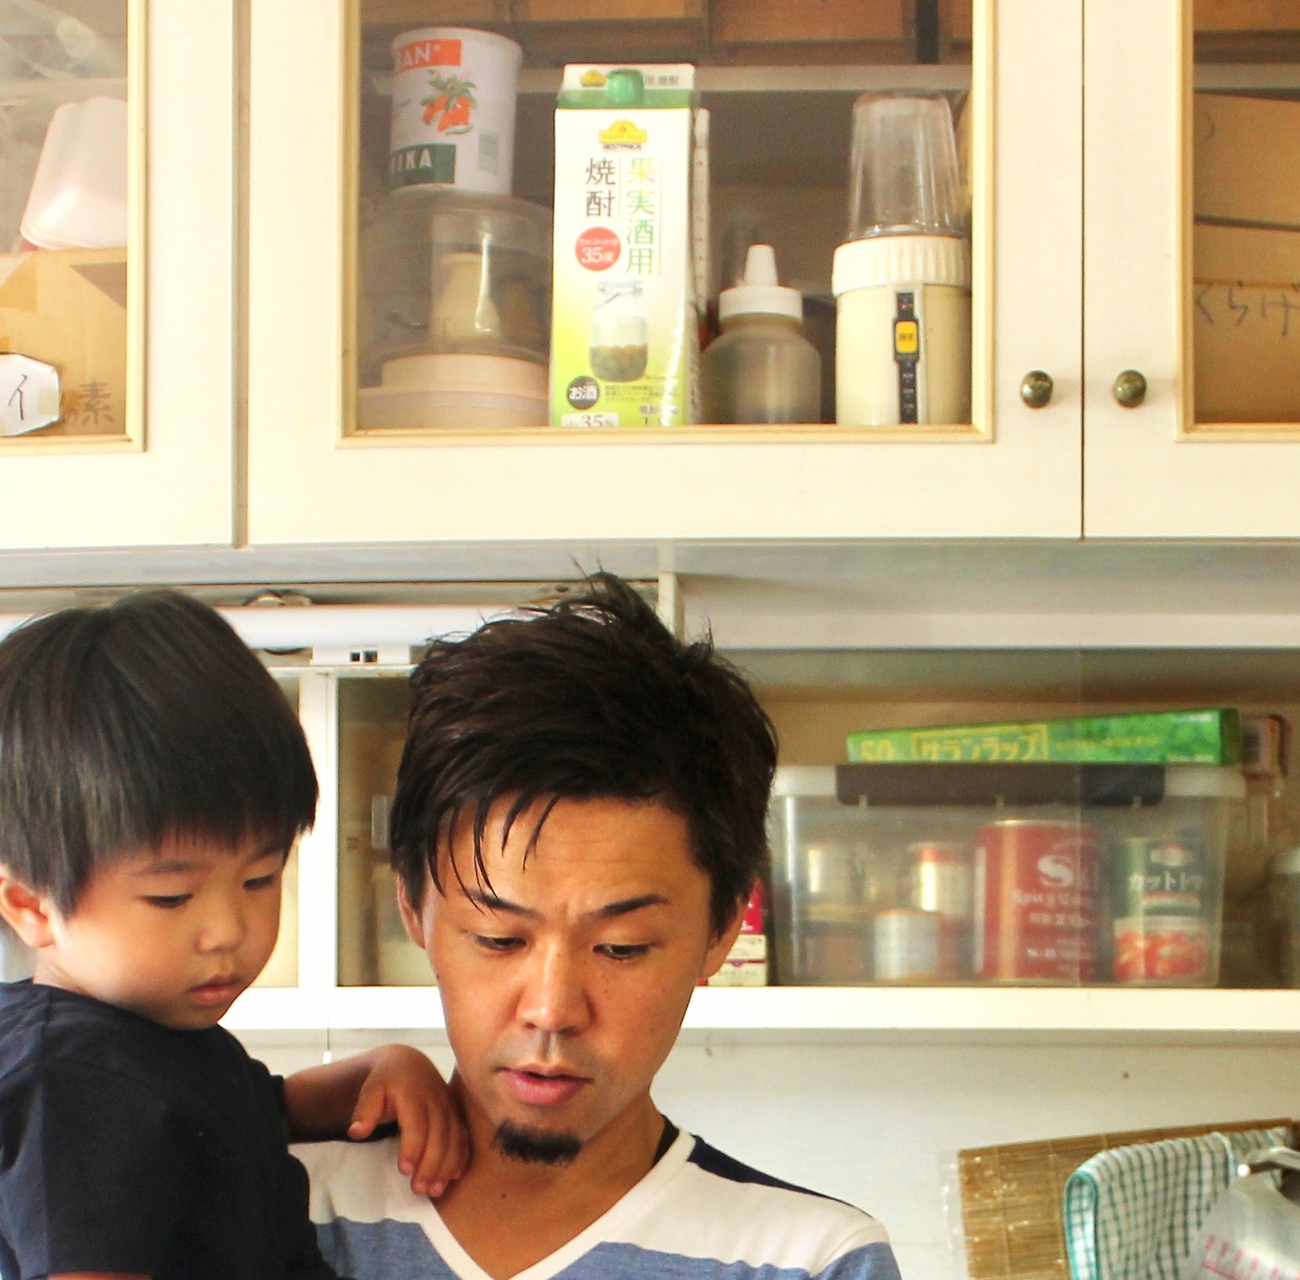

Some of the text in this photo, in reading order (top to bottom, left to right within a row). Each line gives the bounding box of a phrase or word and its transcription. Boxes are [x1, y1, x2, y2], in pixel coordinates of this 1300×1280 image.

[585, 157, 616, 217] 焼酎
[625, 157, 656, 275] 果実酒用
[568, 386, 597, 400] お酒
